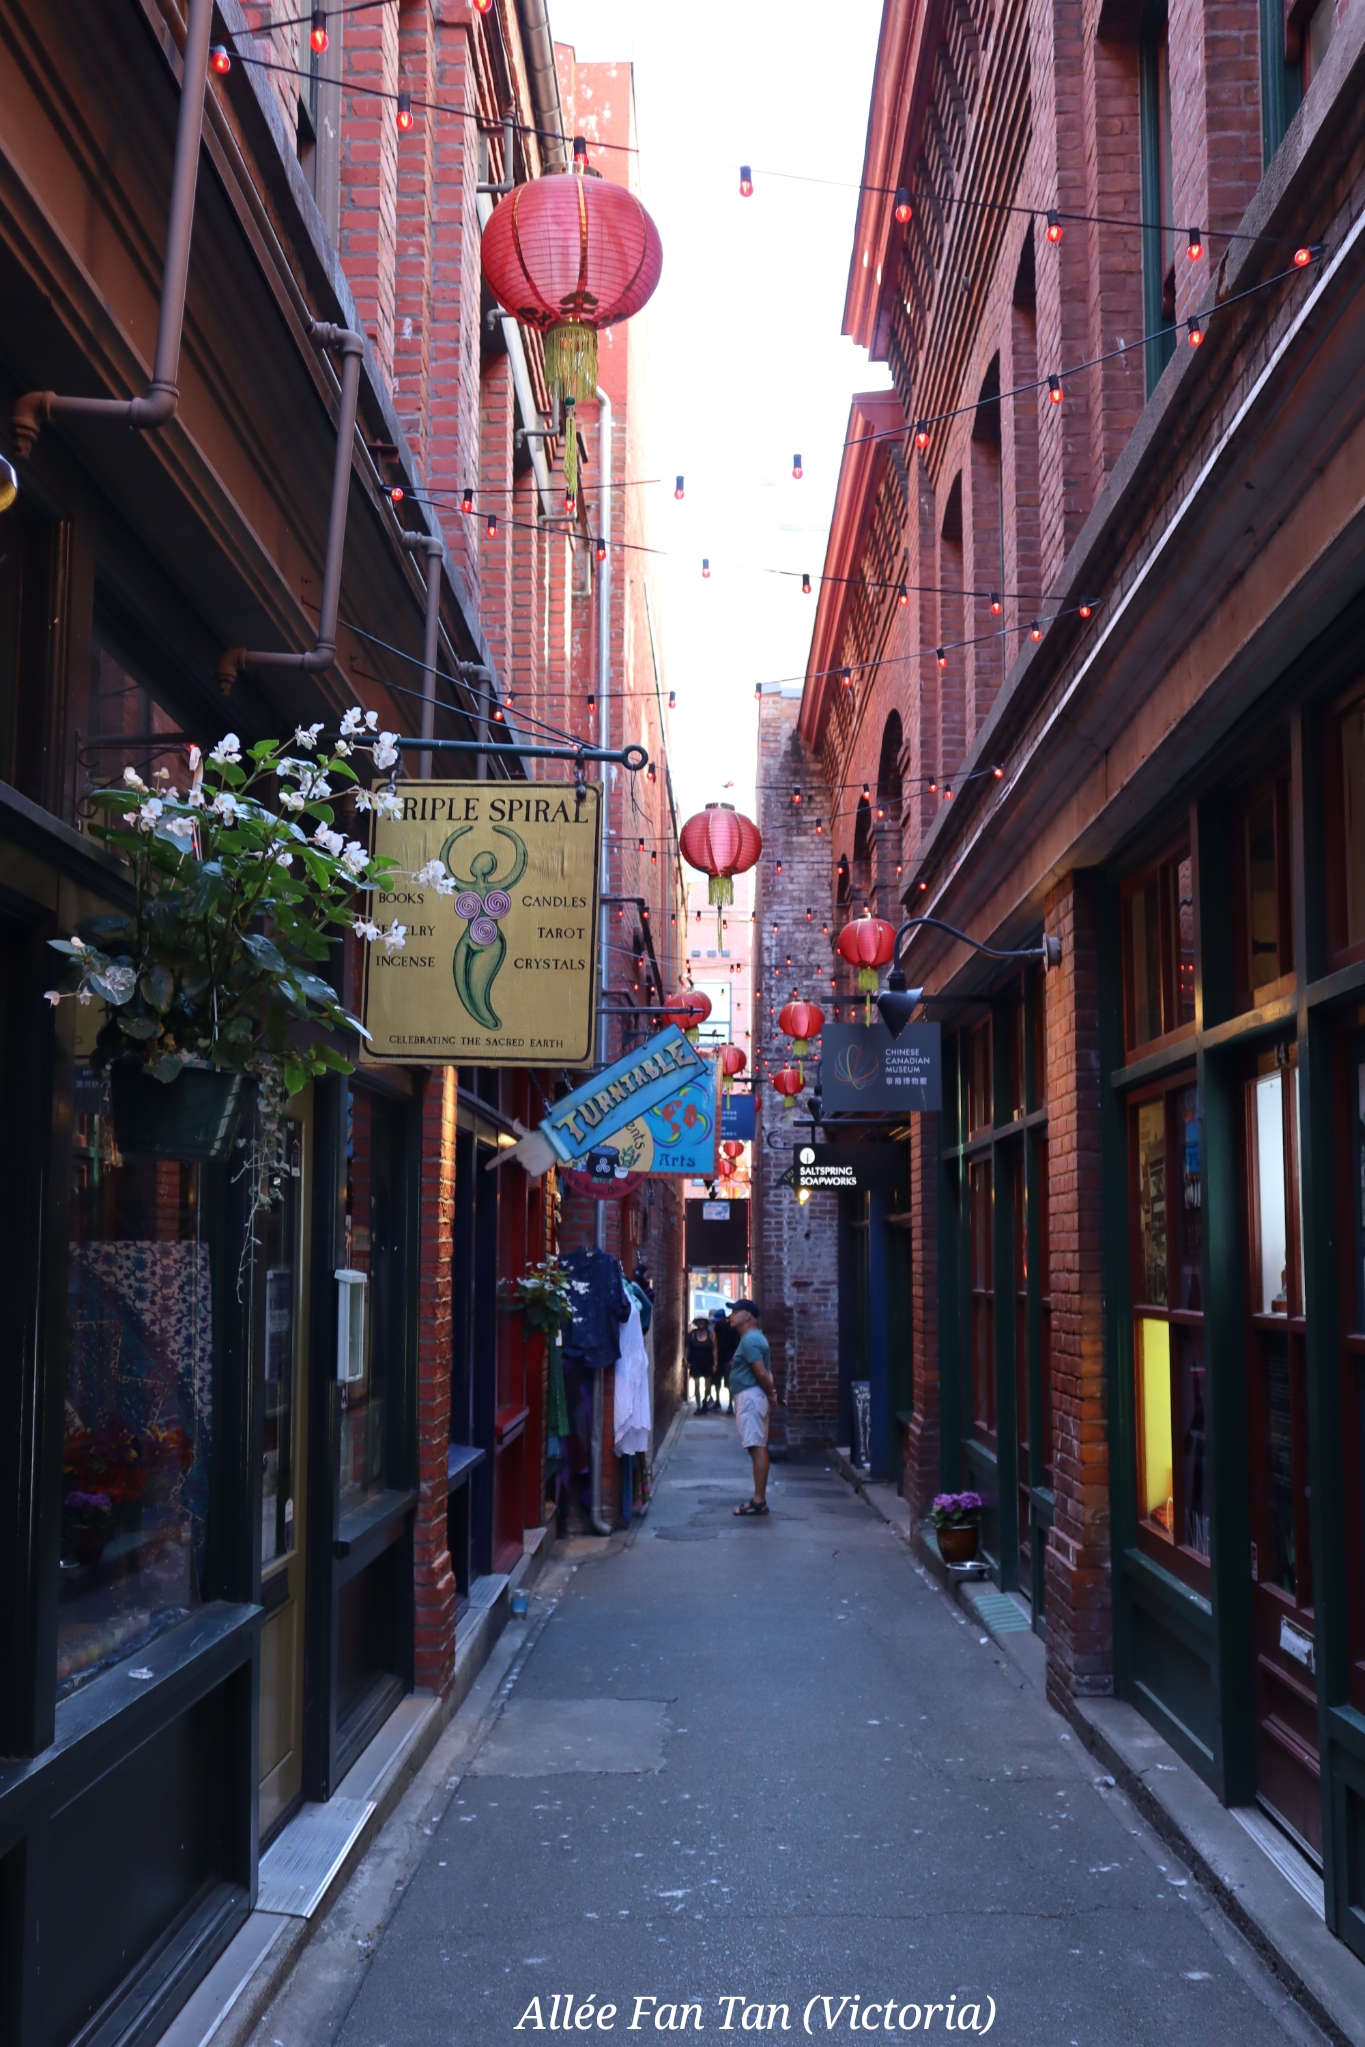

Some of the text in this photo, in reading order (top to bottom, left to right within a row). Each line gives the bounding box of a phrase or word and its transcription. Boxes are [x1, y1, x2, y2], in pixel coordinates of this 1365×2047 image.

[387, 797, 588, 824] RIPLE SPIRAL
[379, 892, 424, 904] BOOKS
[522, 895, 587, 908] CANDLES
[537, 927, 585, 939] TAROT
[375, 955, 435, 968] INCENSE
[513, 957, 585, 971] CRYSTALS
[389, 1035, 563, 1048] CELEBRATING THE SACRED EARTH
[885, 1048, 920, 1056] CHINESE
[885, 1057, 930, 1065] CANADIAN
[552, 1038, 697, 1145] TURNTABLE
[659, 1153, 696, 1168] Arts
[800, 1166, 853, 1176] SALTSPRING
[800, 1176, 857, 1186] SOAPWORKS
